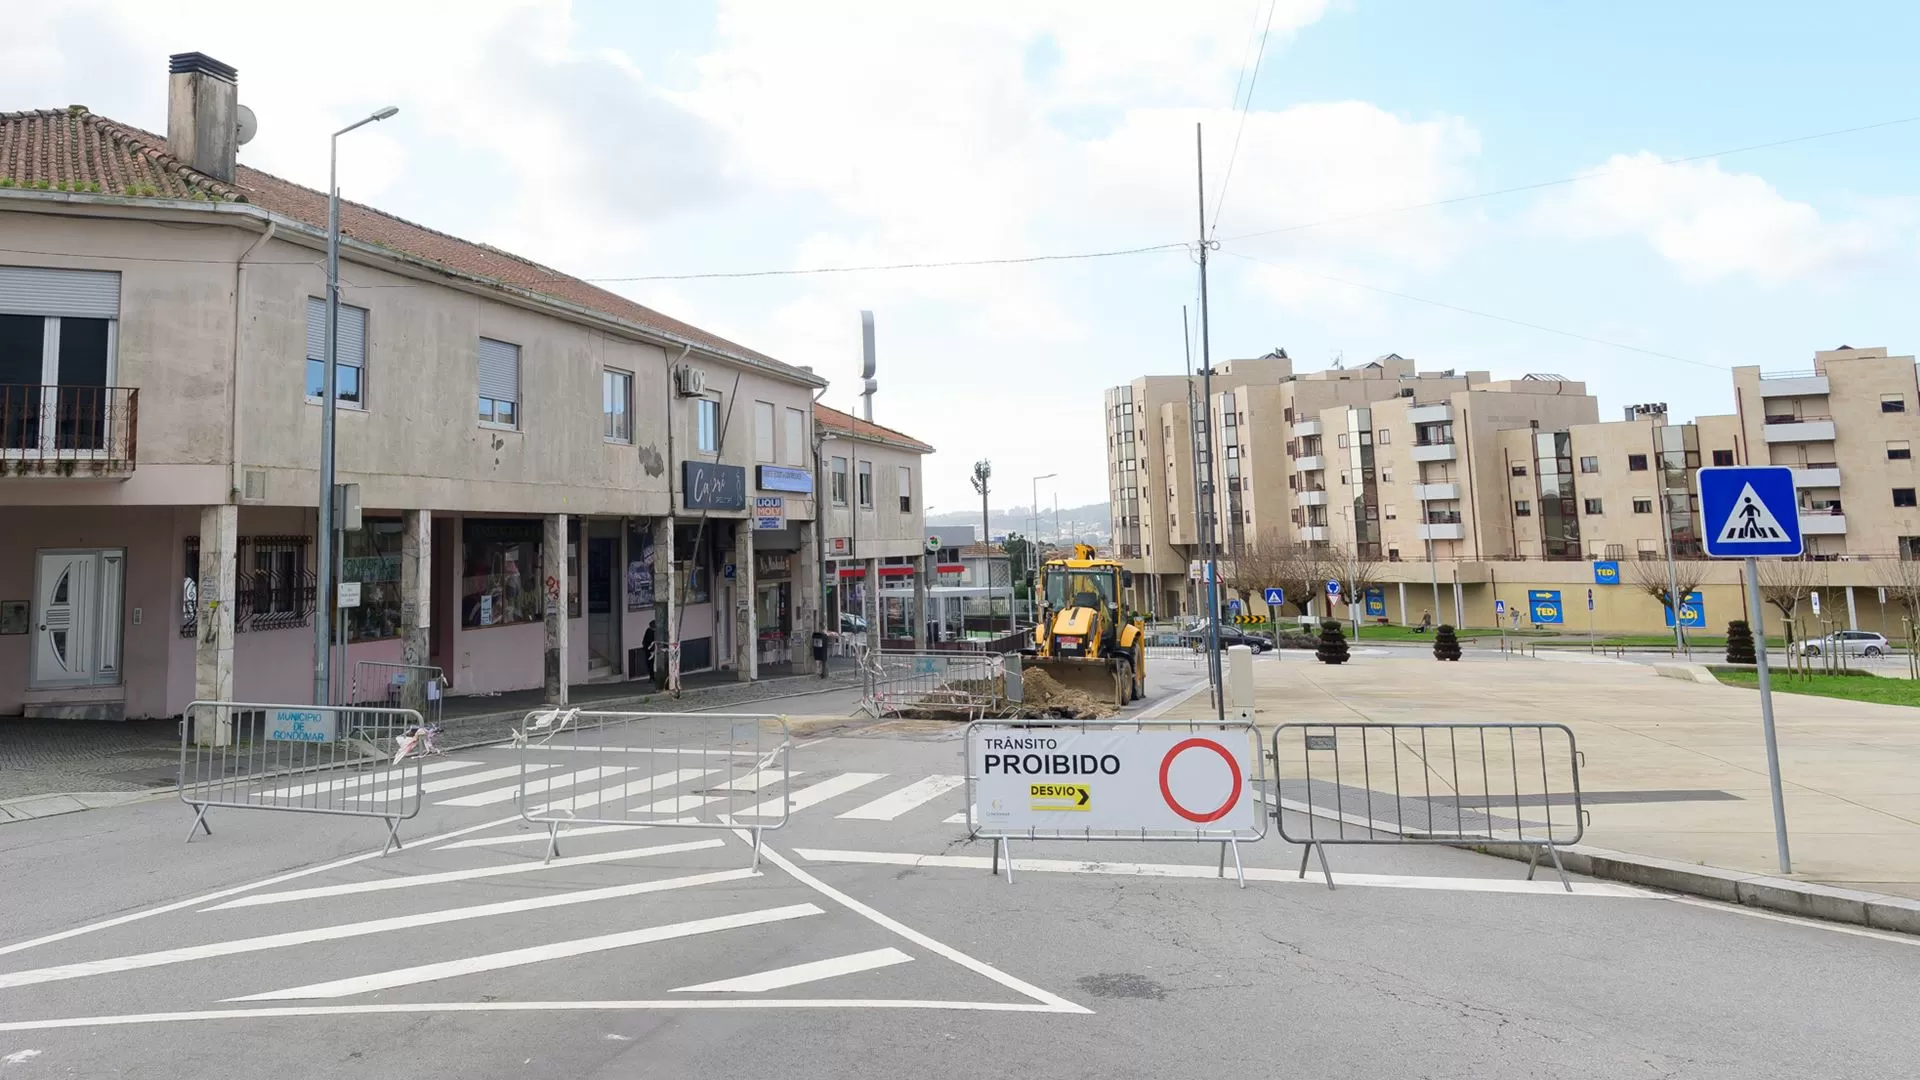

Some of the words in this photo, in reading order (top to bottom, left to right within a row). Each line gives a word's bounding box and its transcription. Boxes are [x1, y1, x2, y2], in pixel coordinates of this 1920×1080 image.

[694, 468, 726, 503] Capri
[757, 499, 780, 507] LIQUI
[757, 508, 780, 516] MOLY
[1597, 568, 1616, 576] TEDi
[1536, 607, 1557, 616] TEDi
[293, 722, 304, 731] DE
[273, 730, 325, 741] GONDOMAR
[984, 736, 1057, 750] TRÂNSITO
[984, 754, 1120, 775] PROIBIDO
[1031, 786, 1075, 796] DESVIO
